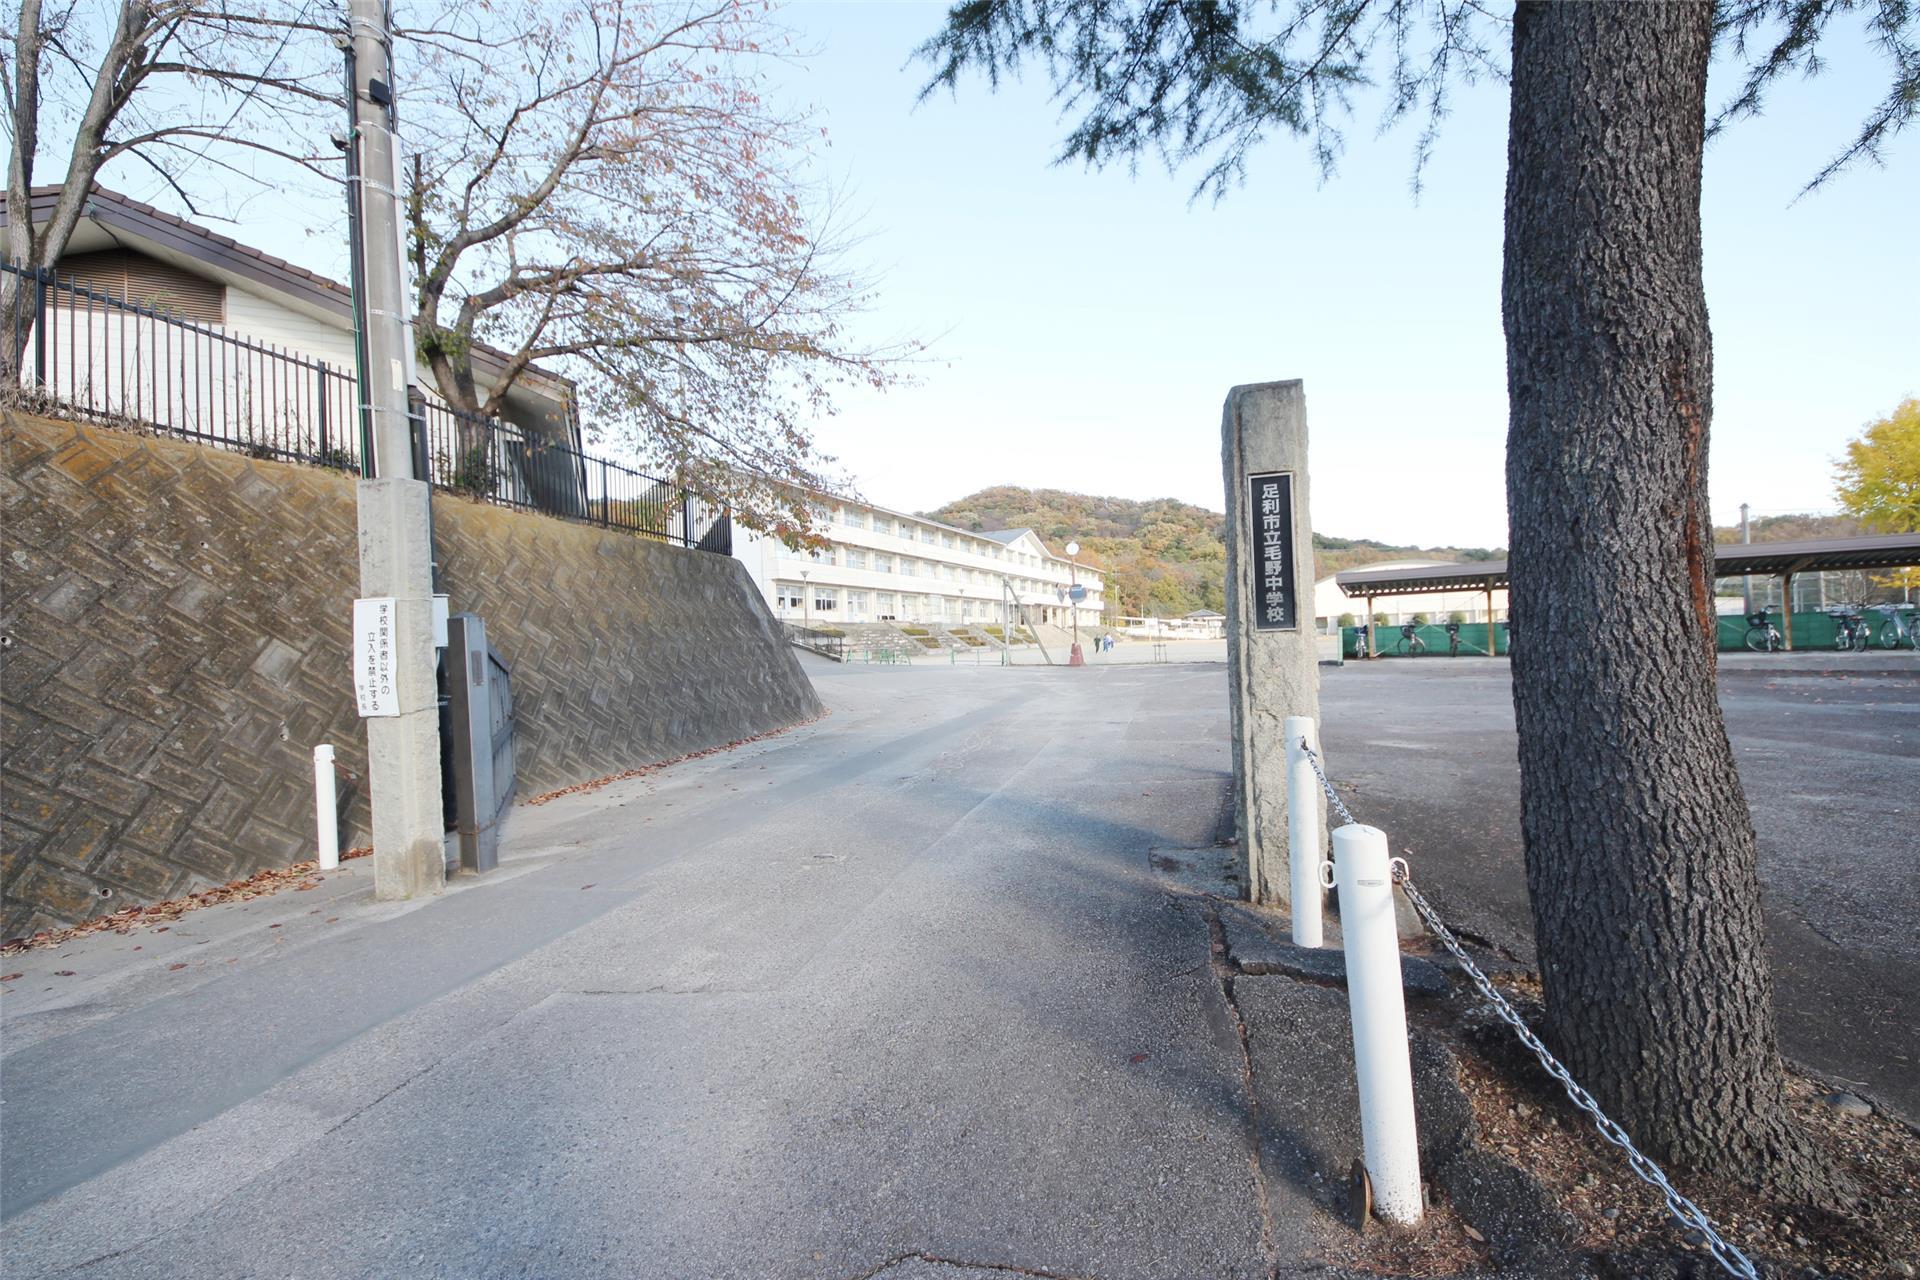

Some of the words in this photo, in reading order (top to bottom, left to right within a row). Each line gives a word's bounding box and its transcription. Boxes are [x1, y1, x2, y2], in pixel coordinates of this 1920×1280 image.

[1262, 484, 1284, 622] 足利市立毛野中学校
[368, 632, 379, 711] 立入を禁止する
[379, 604, 390, 695] 学校関係者以外の
